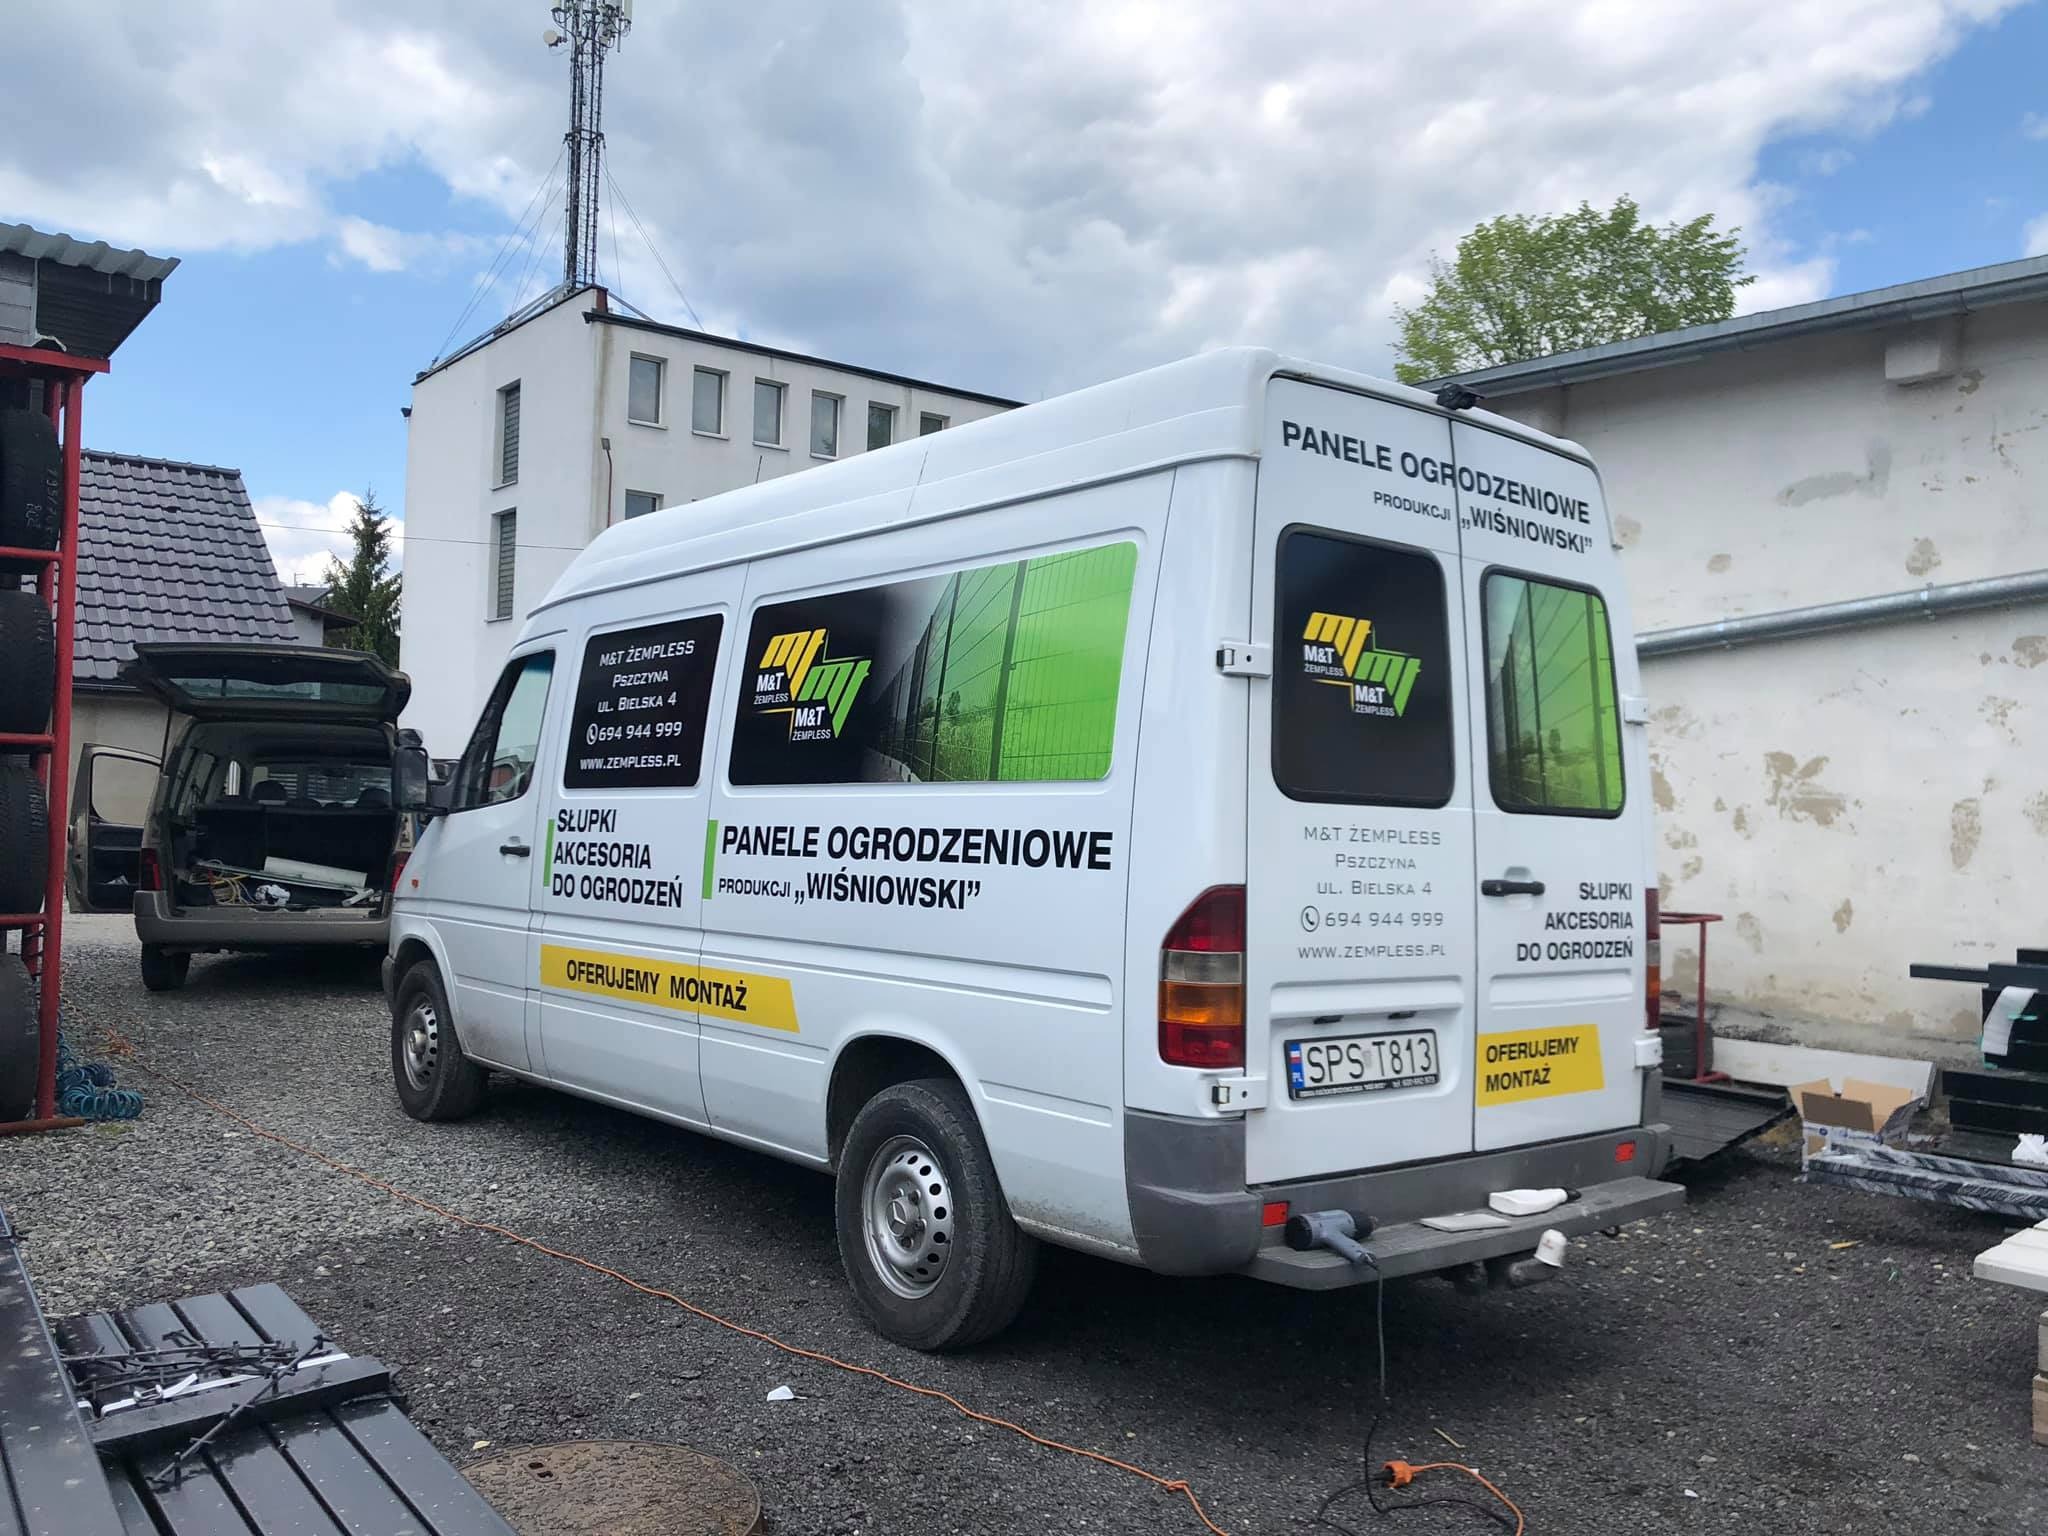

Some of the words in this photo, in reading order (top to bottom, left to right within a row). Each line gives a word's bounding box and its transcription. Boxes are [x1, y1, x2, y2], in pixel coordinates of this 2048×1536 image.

[1282, 420, 1392, 472] PANELE
[1400, 451, 1590, 524] OGRODZENIOWE
[1373, 491, 1451, 521] PRODUKCJI
[600, 650, 624, 667] M&T
[626, 640, 696, 662] ŻEMPLESS
[1304, 645, 1335, 664] M&T
[756, 672, 784, 692] M&T
[667, 692, 677, 706] 4
[1355, 684, 1386, 704] M&T
[794, 706, 825, 727] M&T
[598, 726, 622, 741] 694
[626, 724, 651, 739] 944
[656, 722, 682, 737] 999
[580, 754, 681, 770] WWW.ZEMPLESS.PL
[557, 809, 617, 833] SŁUPKI
[1304, 826, 1342, 841] M&T
[1349, 824, 1441, 846] ŻEMPLESS
[553, 842, 651, 869] AKCESORIA
[722, 825, 820, 857] PANELE
[827, 826, 1113, 871] OGRODZENIOWE
[553, 873, 575, 897] DO
[580, 875, 683, 908] OGRODZEŃ
[718, 878, 791, 898] PRODUKCJI
[1422, 881, 1432, 895] 4
[1579, 882, 1633, 901] SŁUPKI
[1325, 912, 1361, 927] 694
[1369, 912, 1404, 927] 944
[1410, 912, 1444, 926] 999
[1544, 912, 1634, 930] AKCESORIA
[1298, 944, 1446, 959] WWW.ZEMPLESS.PL
[1516, 942, 1541, 962] DO
[1547, 936, 1633, 961] OGRODZEŃ
[567, 960, 660, 995] OFERUJEMY
[670, 975, 747, 1011] MONTAŻ
[1486, 1036, 1579, 1063] OFERUJEMY
[1307, 1043, 1365, 1084] SPS
[1372, 1037, 1432, 1077] T813
[1486, 1063, 1551, 1092] MONTAŻ
